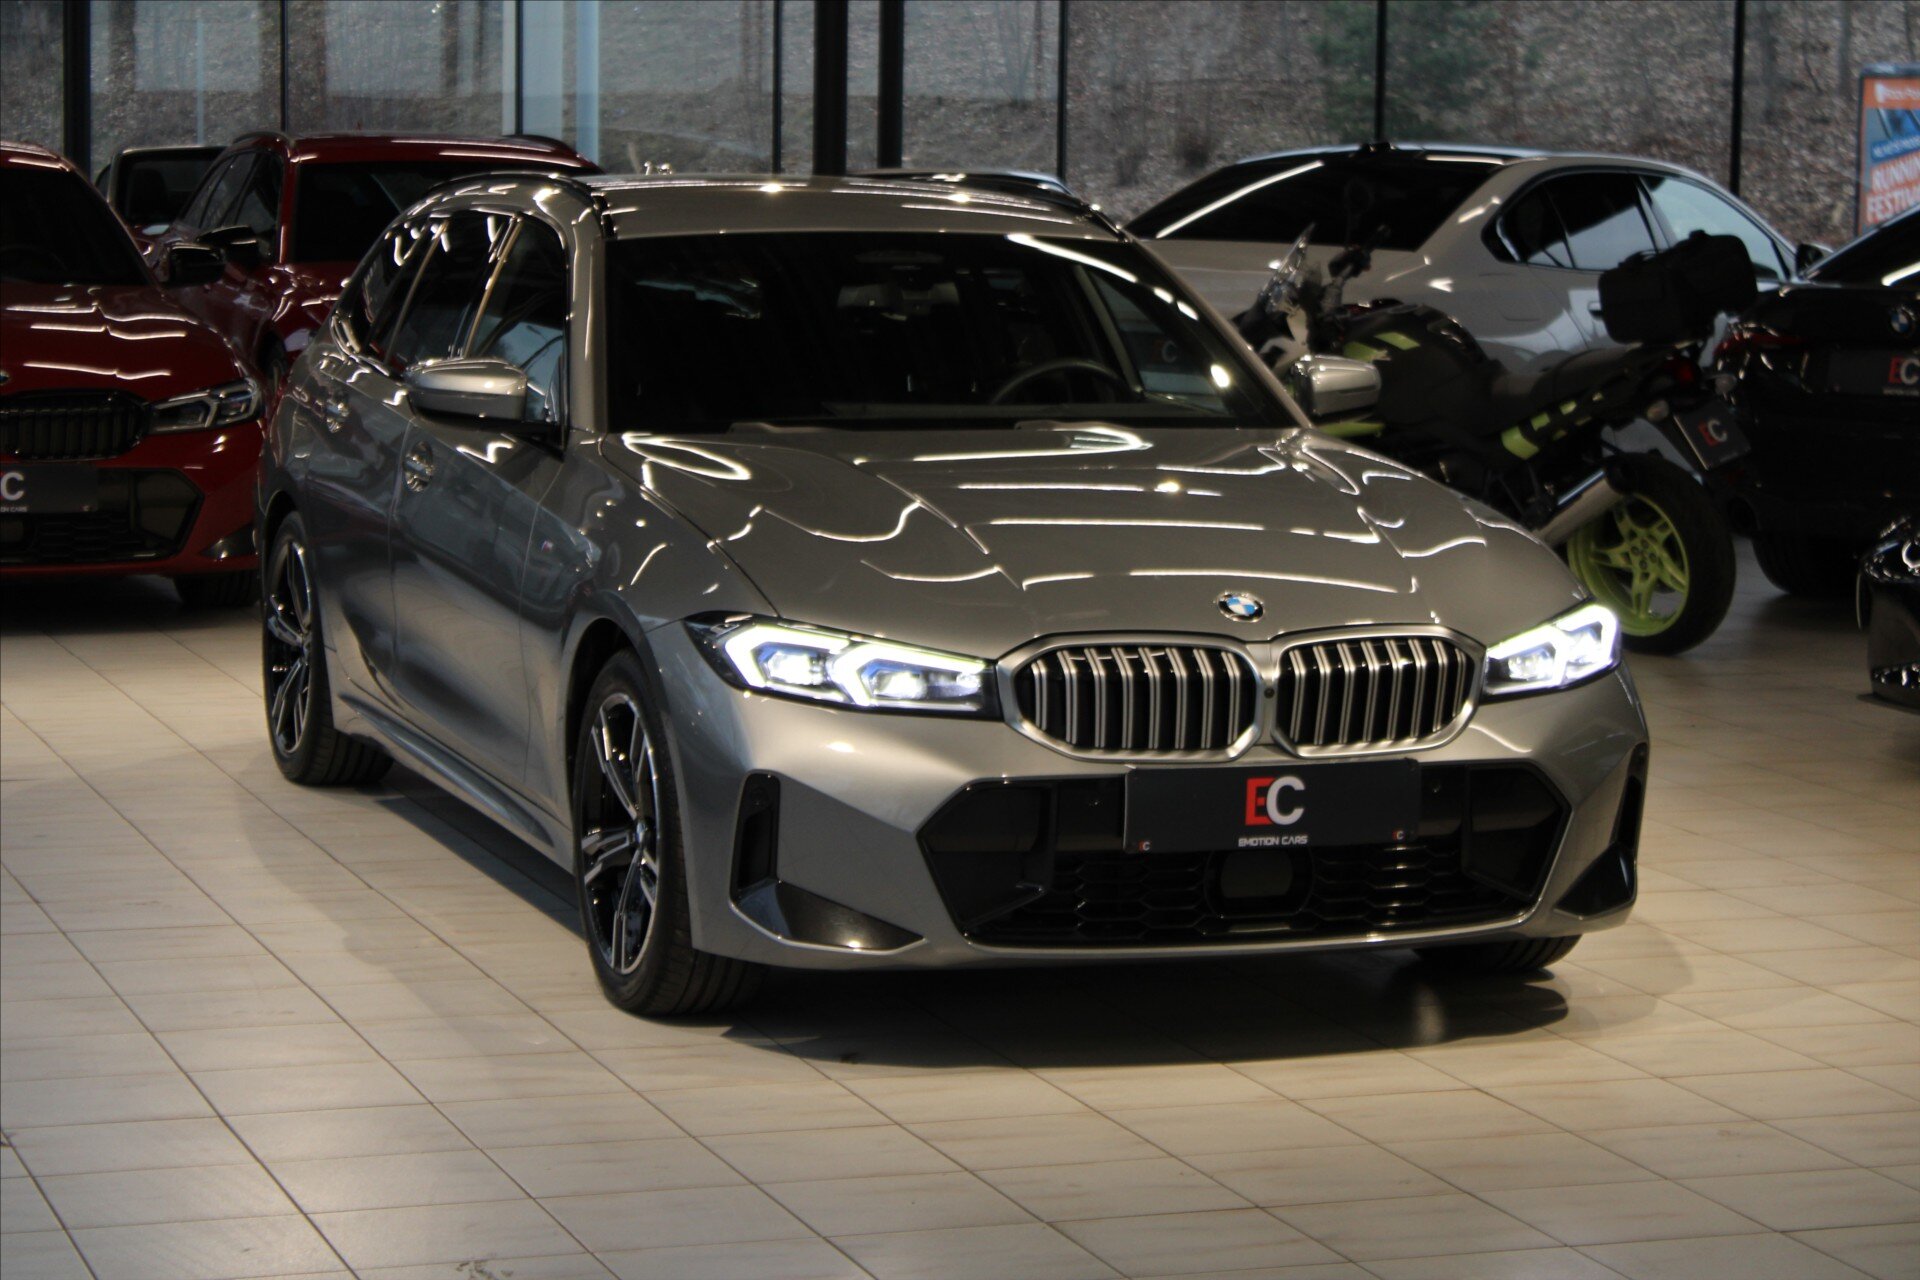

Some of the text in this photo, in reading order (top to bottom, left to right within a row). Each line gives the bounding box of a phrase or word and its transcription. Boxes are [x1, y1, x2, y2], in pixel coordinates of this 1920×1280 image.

[0, 472, 24, 501] C
[1245, 776, 1305, 825] EC
[1238, 835, 1308, 847] EMOTION CARS
